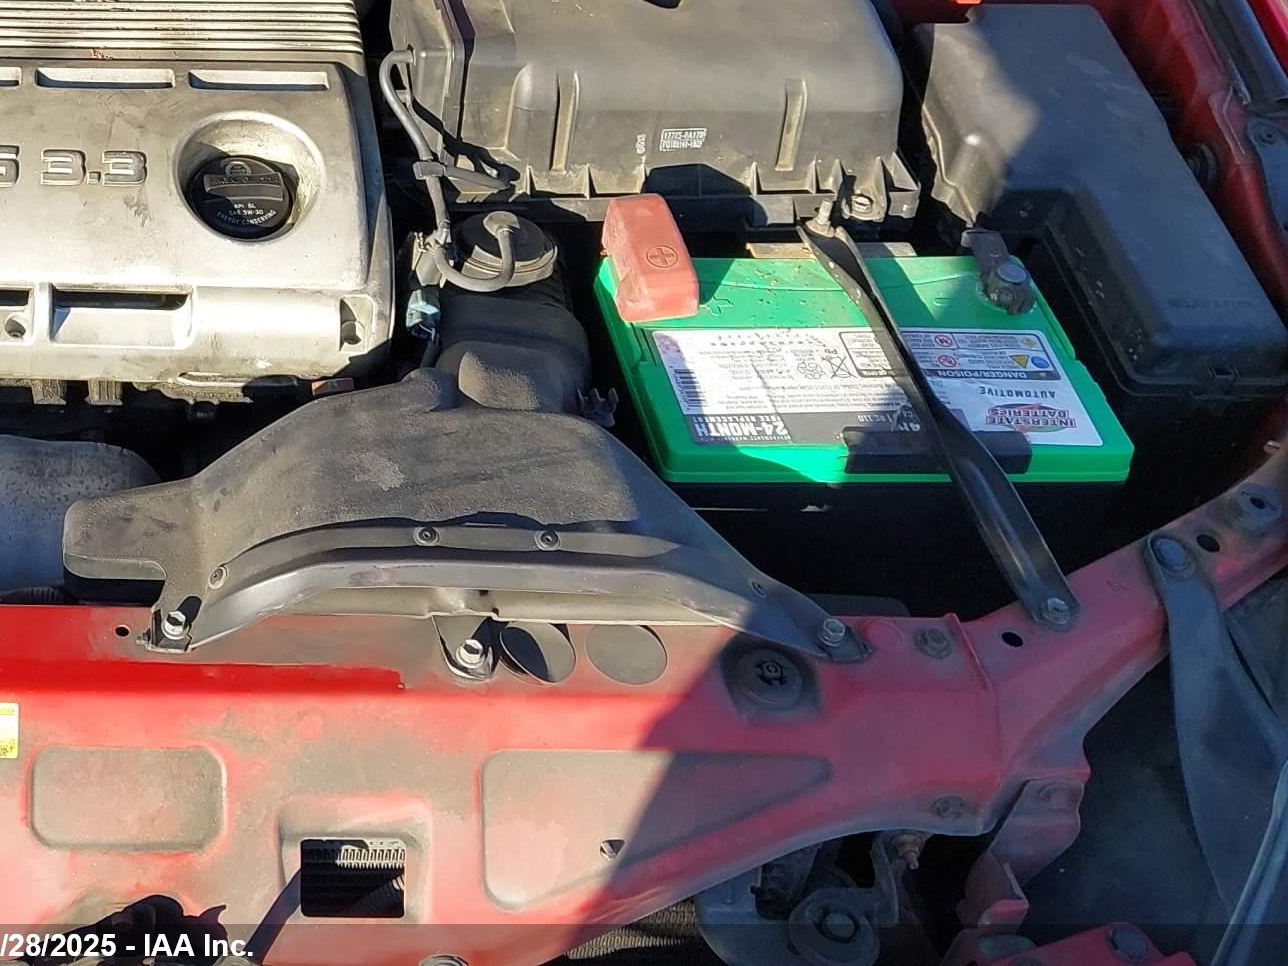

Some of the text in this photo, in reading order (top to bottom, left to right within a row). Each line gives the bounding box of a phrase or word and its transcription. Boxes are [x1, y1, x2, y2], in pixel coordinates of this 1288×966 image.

[39, 149, 148, 187] 3.3
[937, 370, 1028, 379] DANGER/POISON
[978, 387, 1057, 399] AUTOMOTIVE
[987, 408, 1070, 418] BATTERIES
[985, 416, 1076, 428] INTERSTATE
[694, 421, 789, 437] 24-MONTH
